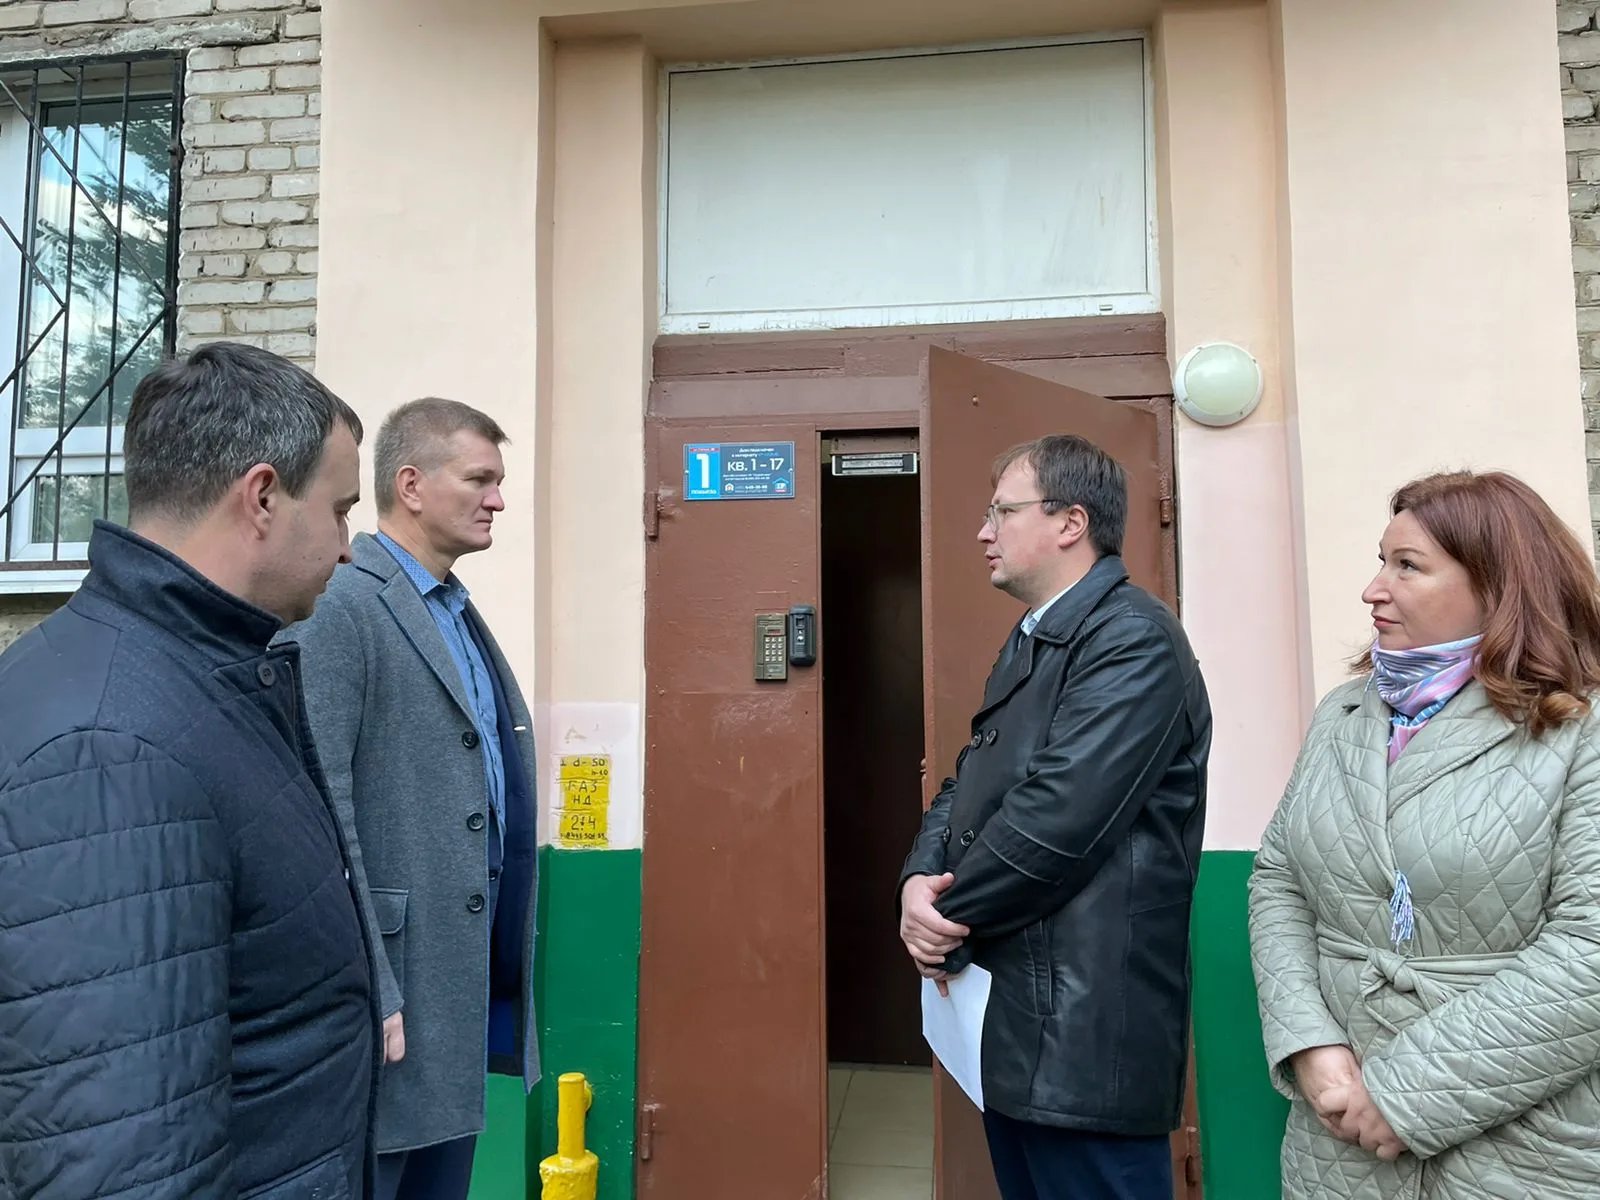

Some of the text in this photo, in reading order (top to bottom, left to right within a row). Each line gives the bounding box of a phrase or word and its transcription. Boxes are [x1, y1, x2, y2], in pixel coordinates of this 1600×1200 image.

[696, 454, 710, 488] 1
[751, 458, 757, 471] 1
[769, 458, 784, 470] 17
[568, 780, 597, 793] ГАЗ
[573, 794, 591, 805] НД
